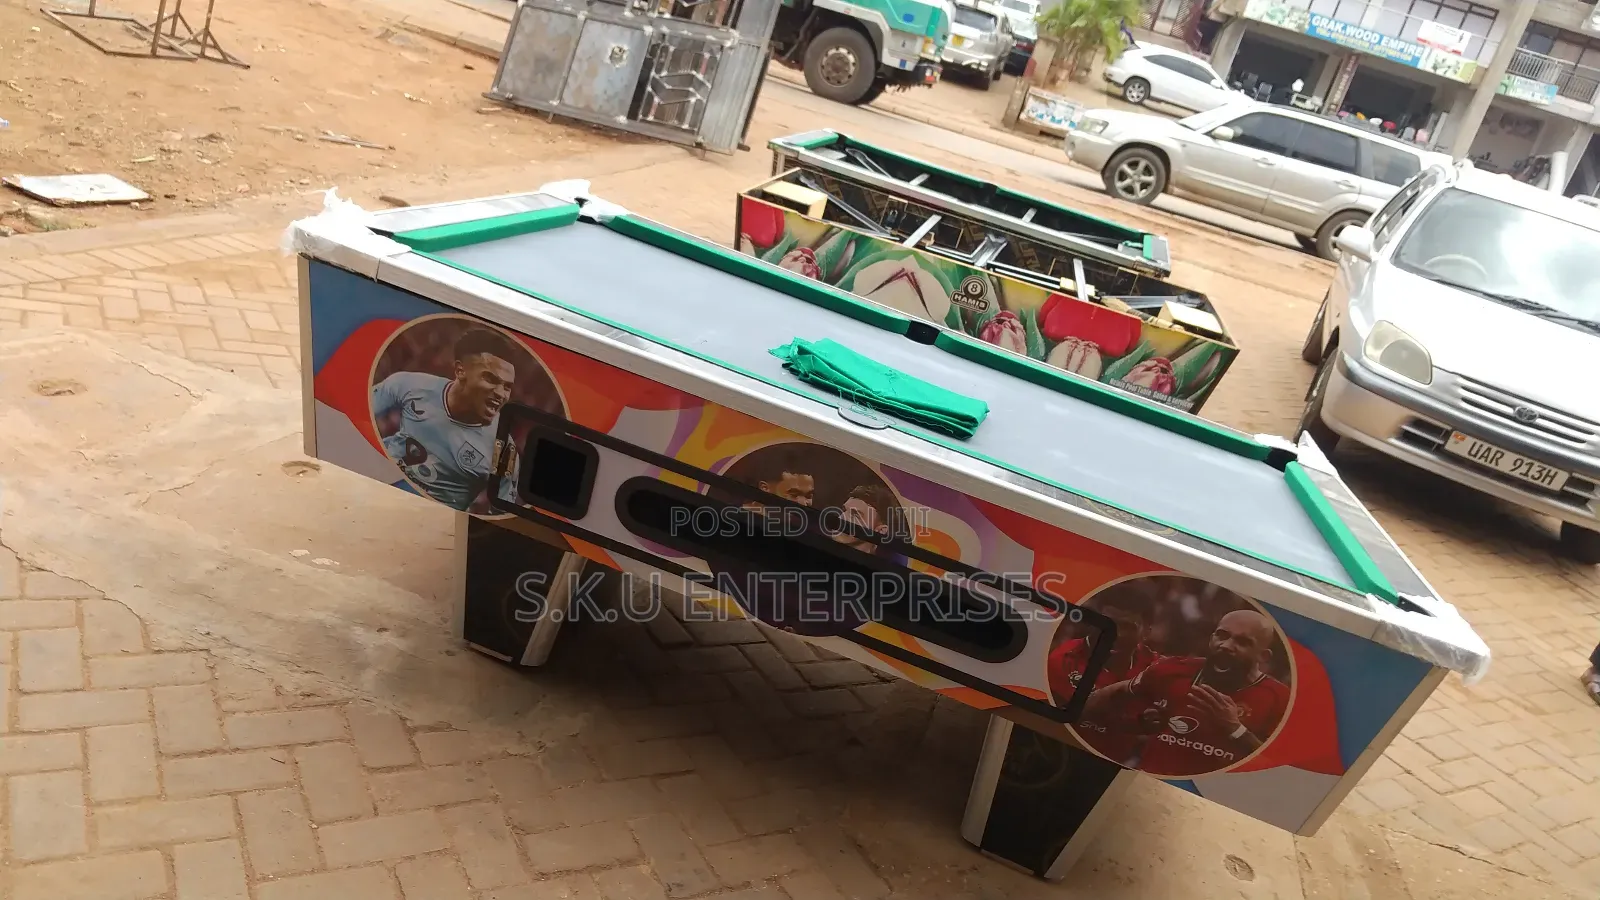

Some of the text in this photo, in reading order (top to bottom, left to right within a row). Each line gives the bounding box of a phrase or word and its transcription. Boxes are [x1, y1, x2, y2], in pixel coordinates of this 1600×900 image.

[1380, 35, 1425, 57] EMPIRE
[954, 294, 986, 308] HAMIS
[1467, 441, 1559, 486] UAR 913H
[1157, 733, 1235, 761] apdragon
